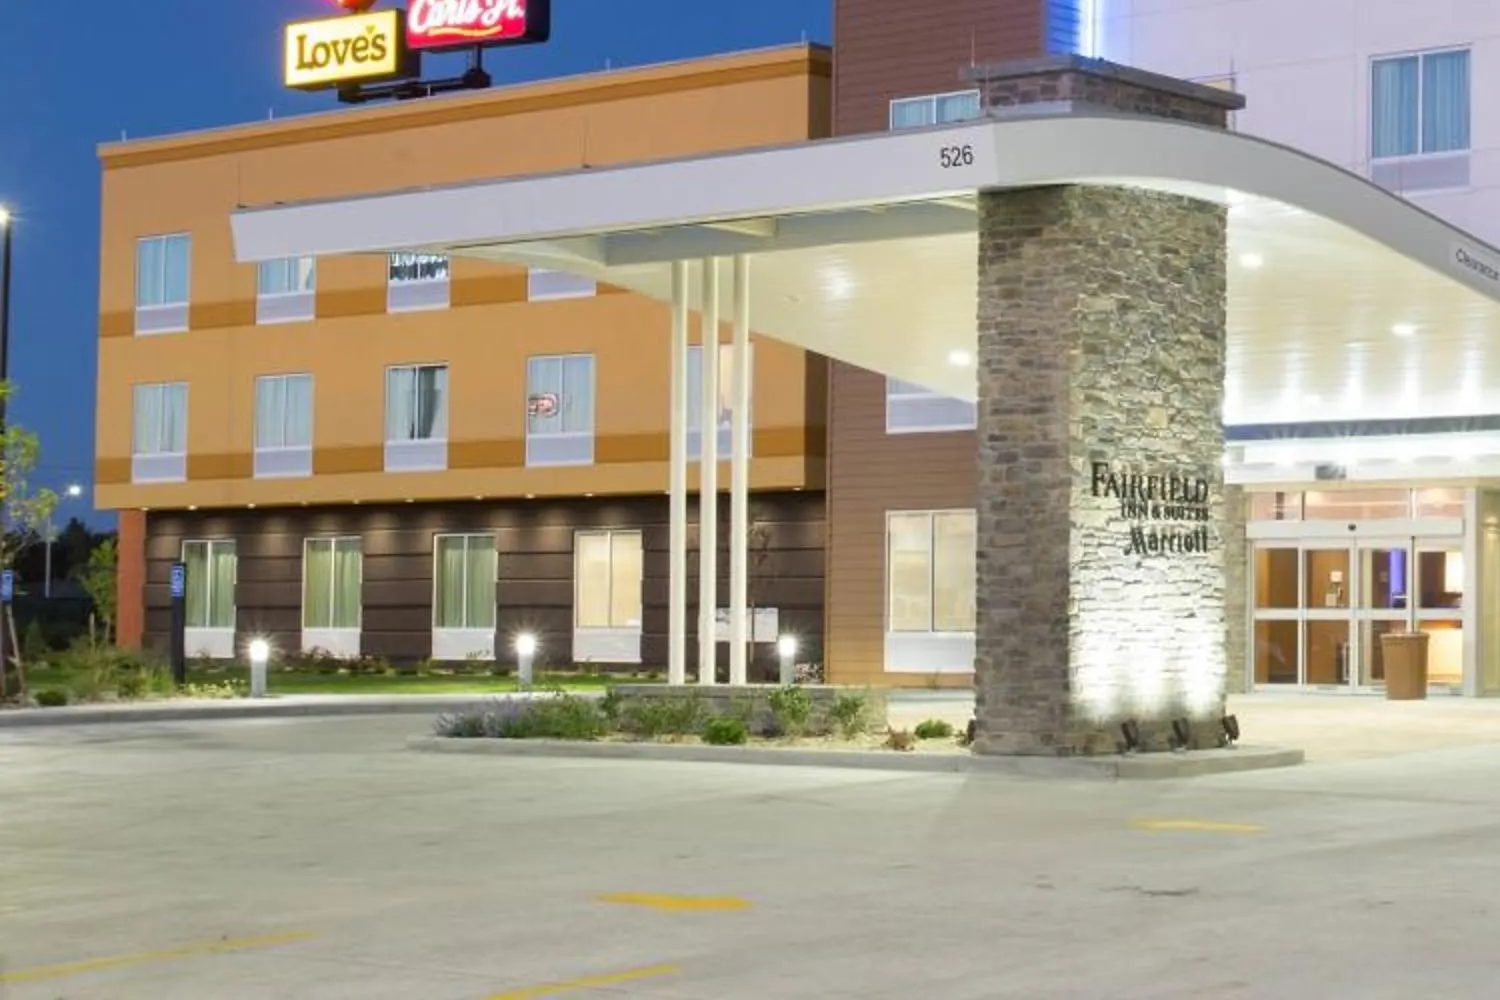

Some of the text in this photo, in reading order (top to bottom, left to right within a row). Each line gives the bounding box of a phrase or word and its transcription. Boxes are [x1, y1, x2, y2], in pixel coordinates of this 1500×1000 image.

[295, 26, 387, 71] Love's
[940, 145, 974, 169] 526
[1091, 462, 1209, 504] FAIRFIELD
[1121, 501, 1148, 519] INN
[1123, 525, 1209, 556] Marriott
